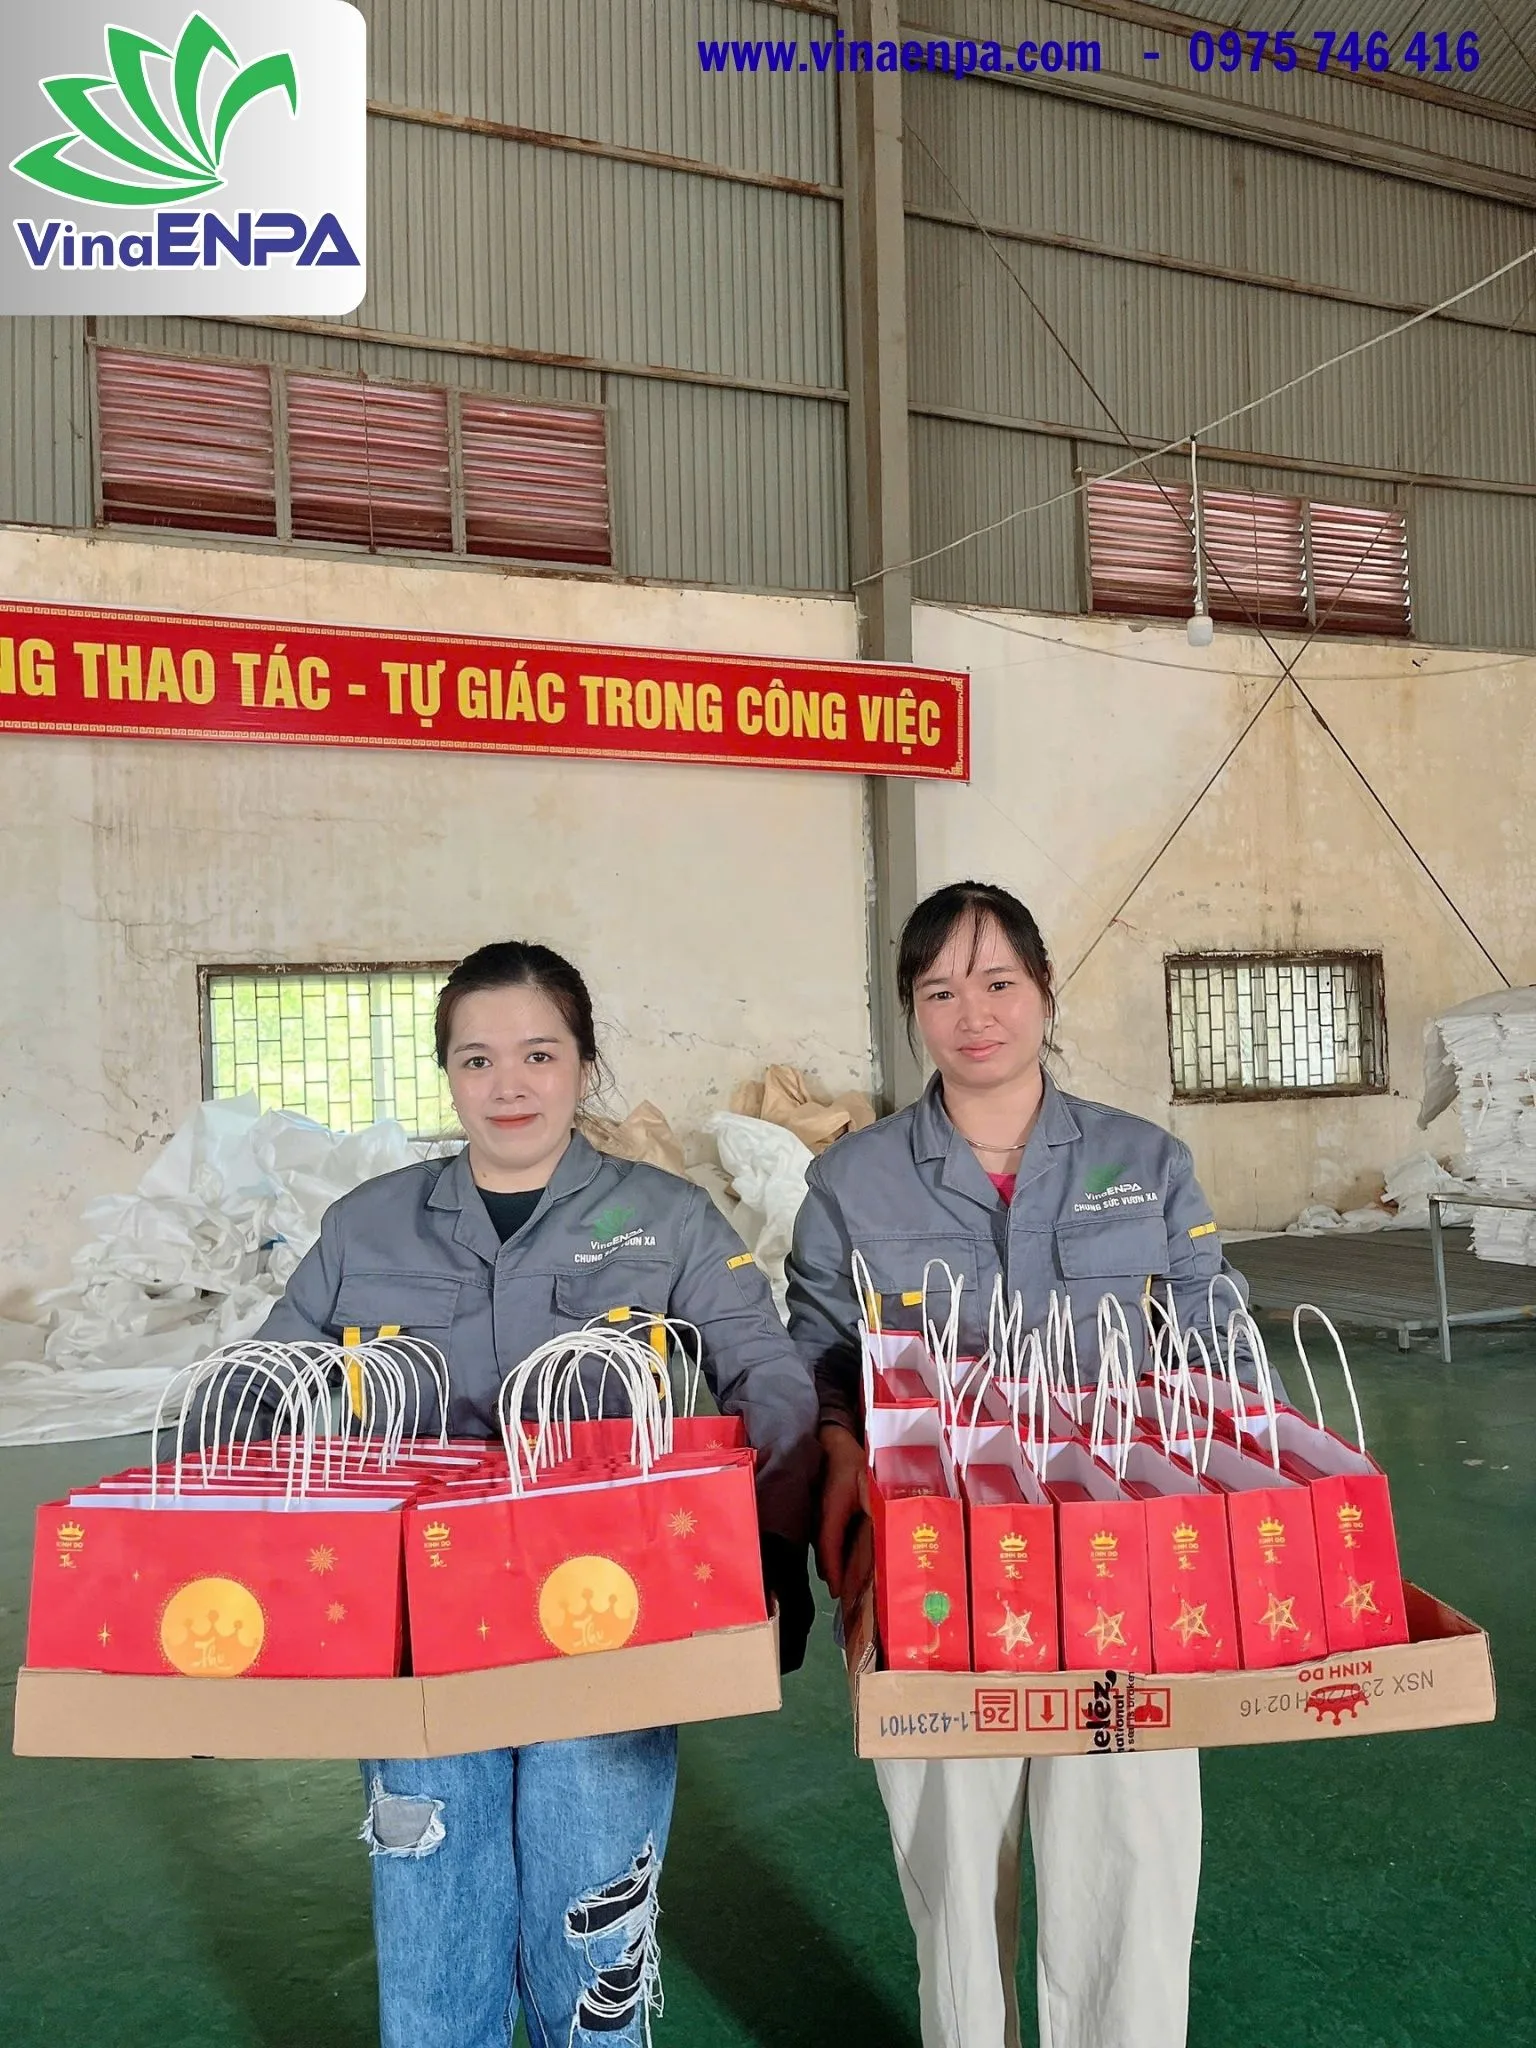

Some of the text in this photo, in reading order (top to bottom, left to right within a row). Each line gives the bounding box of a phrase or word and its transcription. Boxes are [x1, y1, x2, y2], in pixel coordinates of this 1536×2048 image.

[73, 641, 216, 706] THAO
[233, 644, 331, 711] TÁC
[348, 683, 366, 696] -
[381, 659, 446, 728] TỰ
[458, 659, 565, 722] GIÁC
[579, 675, 723, 734] TRONG
[737, 678, 847, 740] CÔNG
[858, 688, 941, 755] VIỆC
[1074, 1203, 1102, 1212] CHUNG
[1299, 1660, 1372, 1682] KINH DO
[1392, 1669, 1434, 1696] NSX
[982, 1707, 1010, 1724] 26
